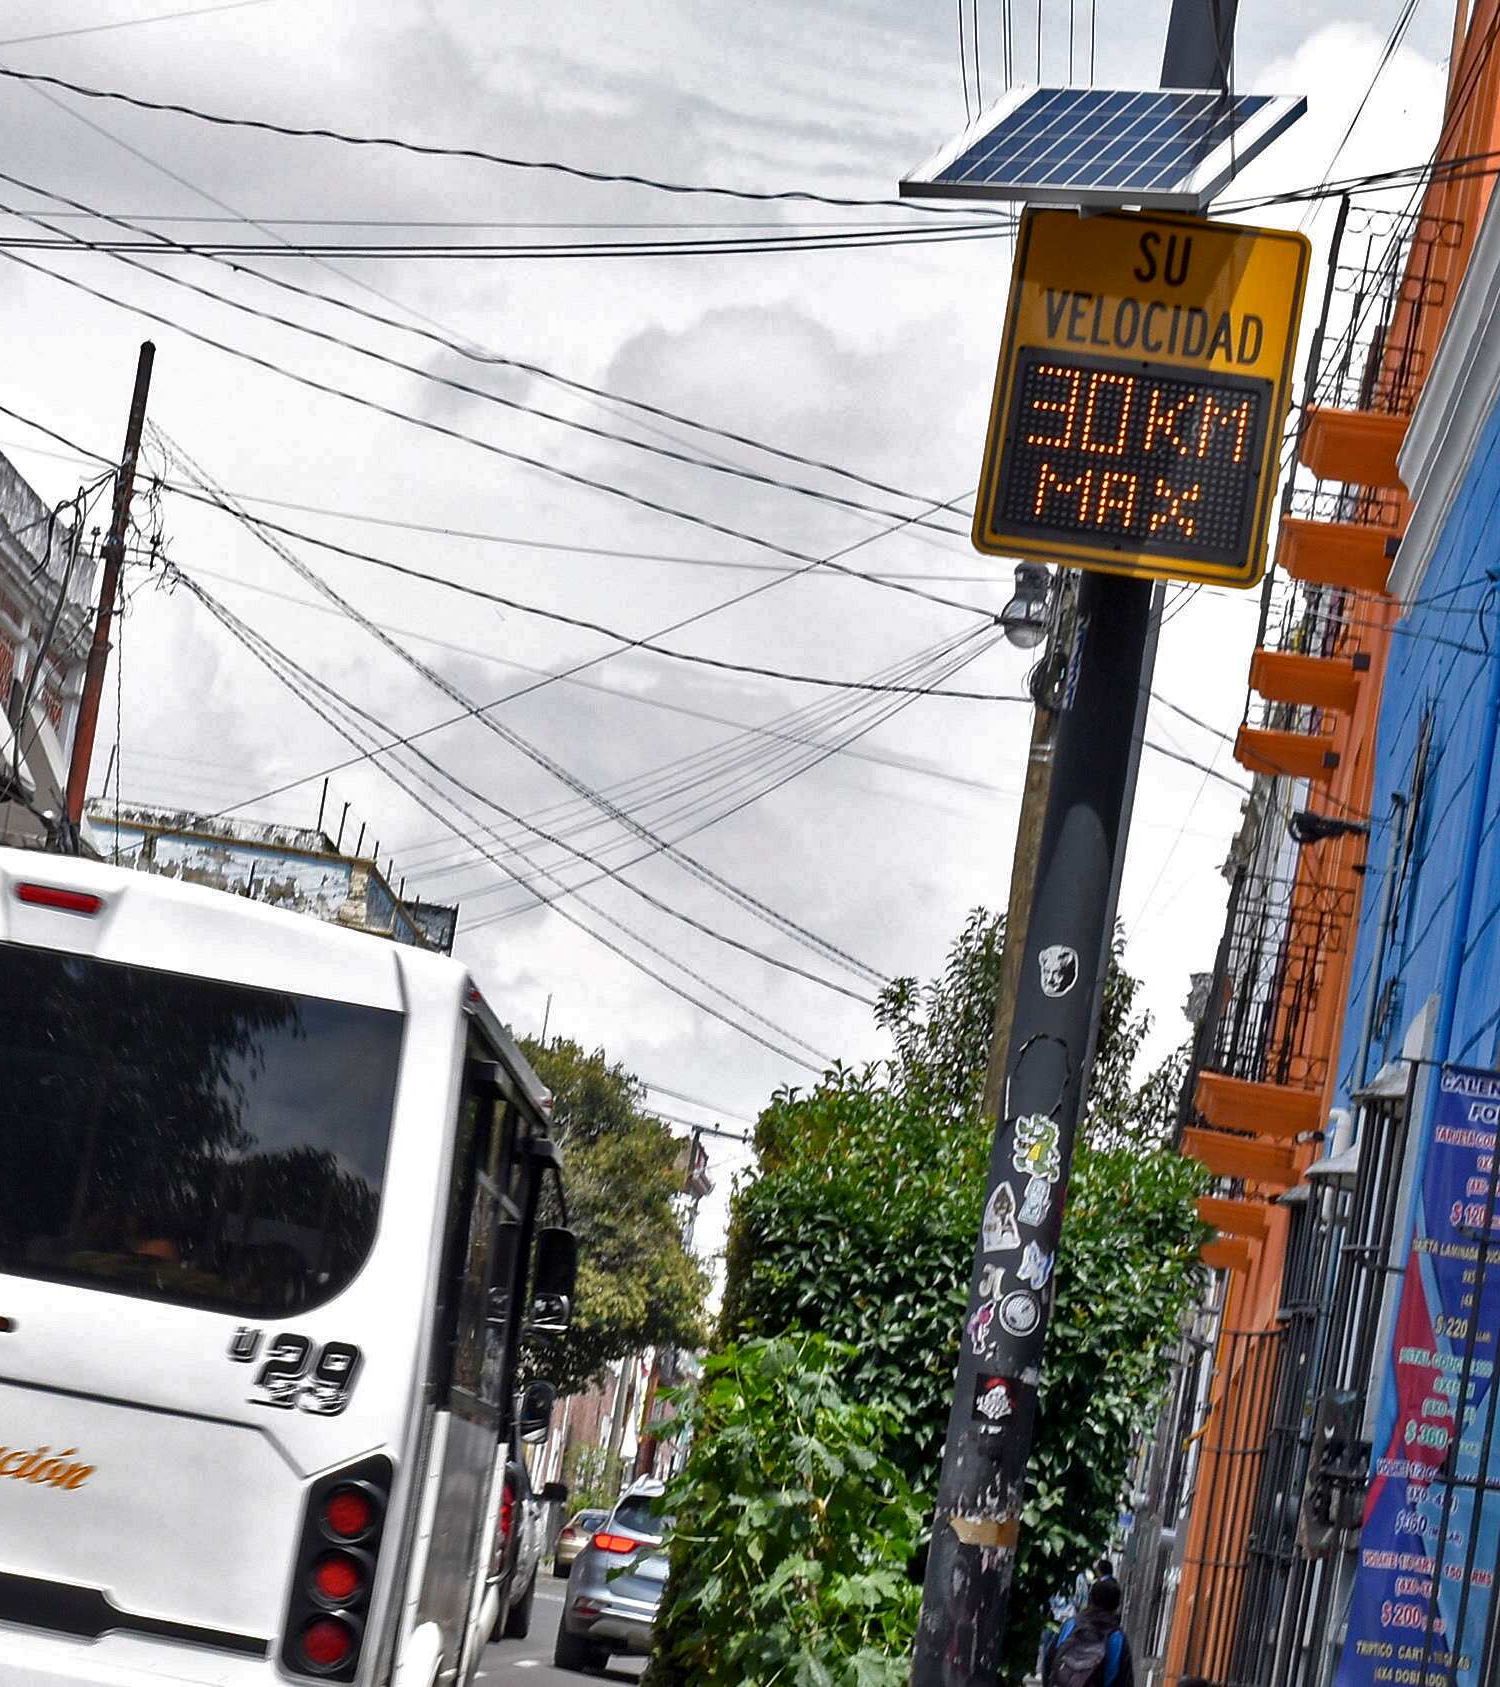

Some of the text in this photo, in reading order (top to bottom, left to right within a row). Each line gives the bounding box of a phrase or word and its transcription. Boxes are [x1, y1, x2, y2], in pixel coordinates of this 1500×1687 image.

[1133, 230, 1193, 288] SU
[1046, 288, 1264, 366] VELOCIDAD
[1033, 462, 1200, 537] MAX
